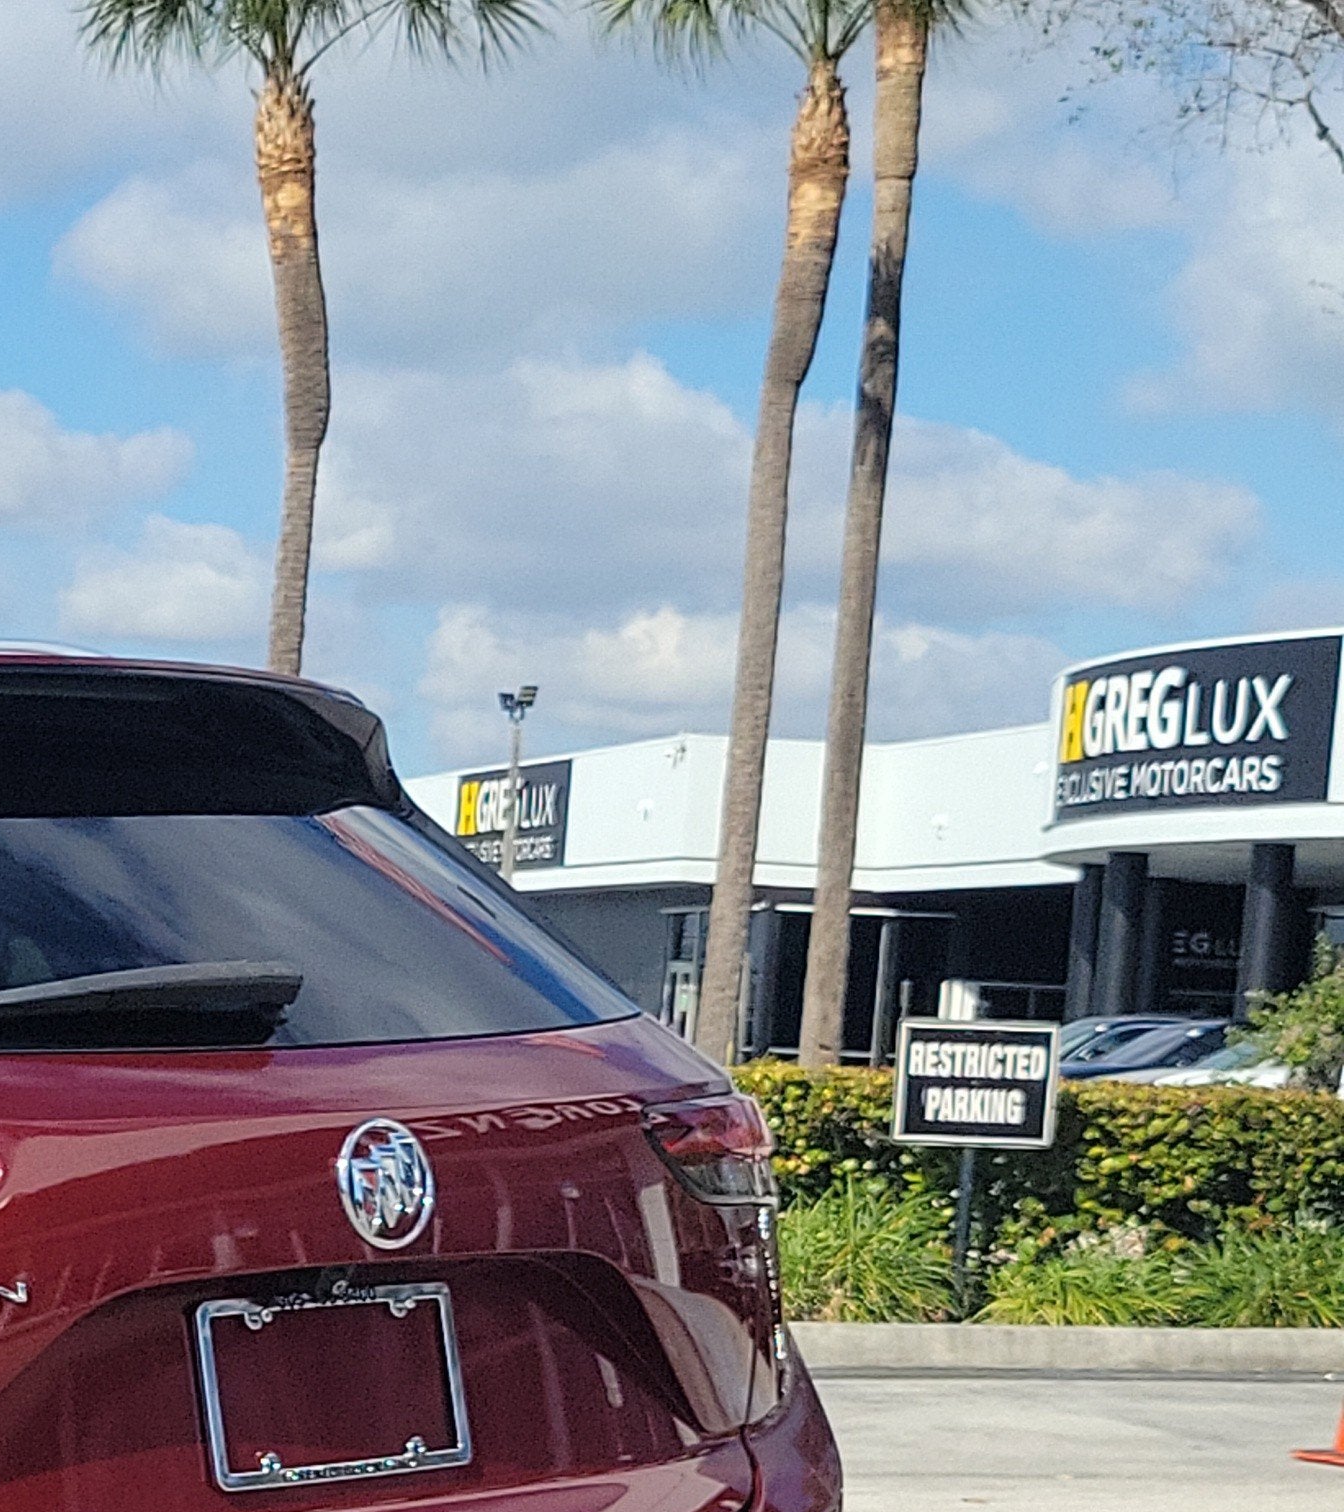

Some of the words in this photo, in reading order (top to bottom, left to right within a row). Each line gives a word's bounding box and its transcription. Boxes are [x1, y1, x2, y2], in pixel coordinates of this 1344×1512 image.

[1130, 754, 1288, 797] MOTORCARS
[908, 1041, 1047, 1081] RESTRICTED
[923, 1086, 1028, 1125] PARKING
